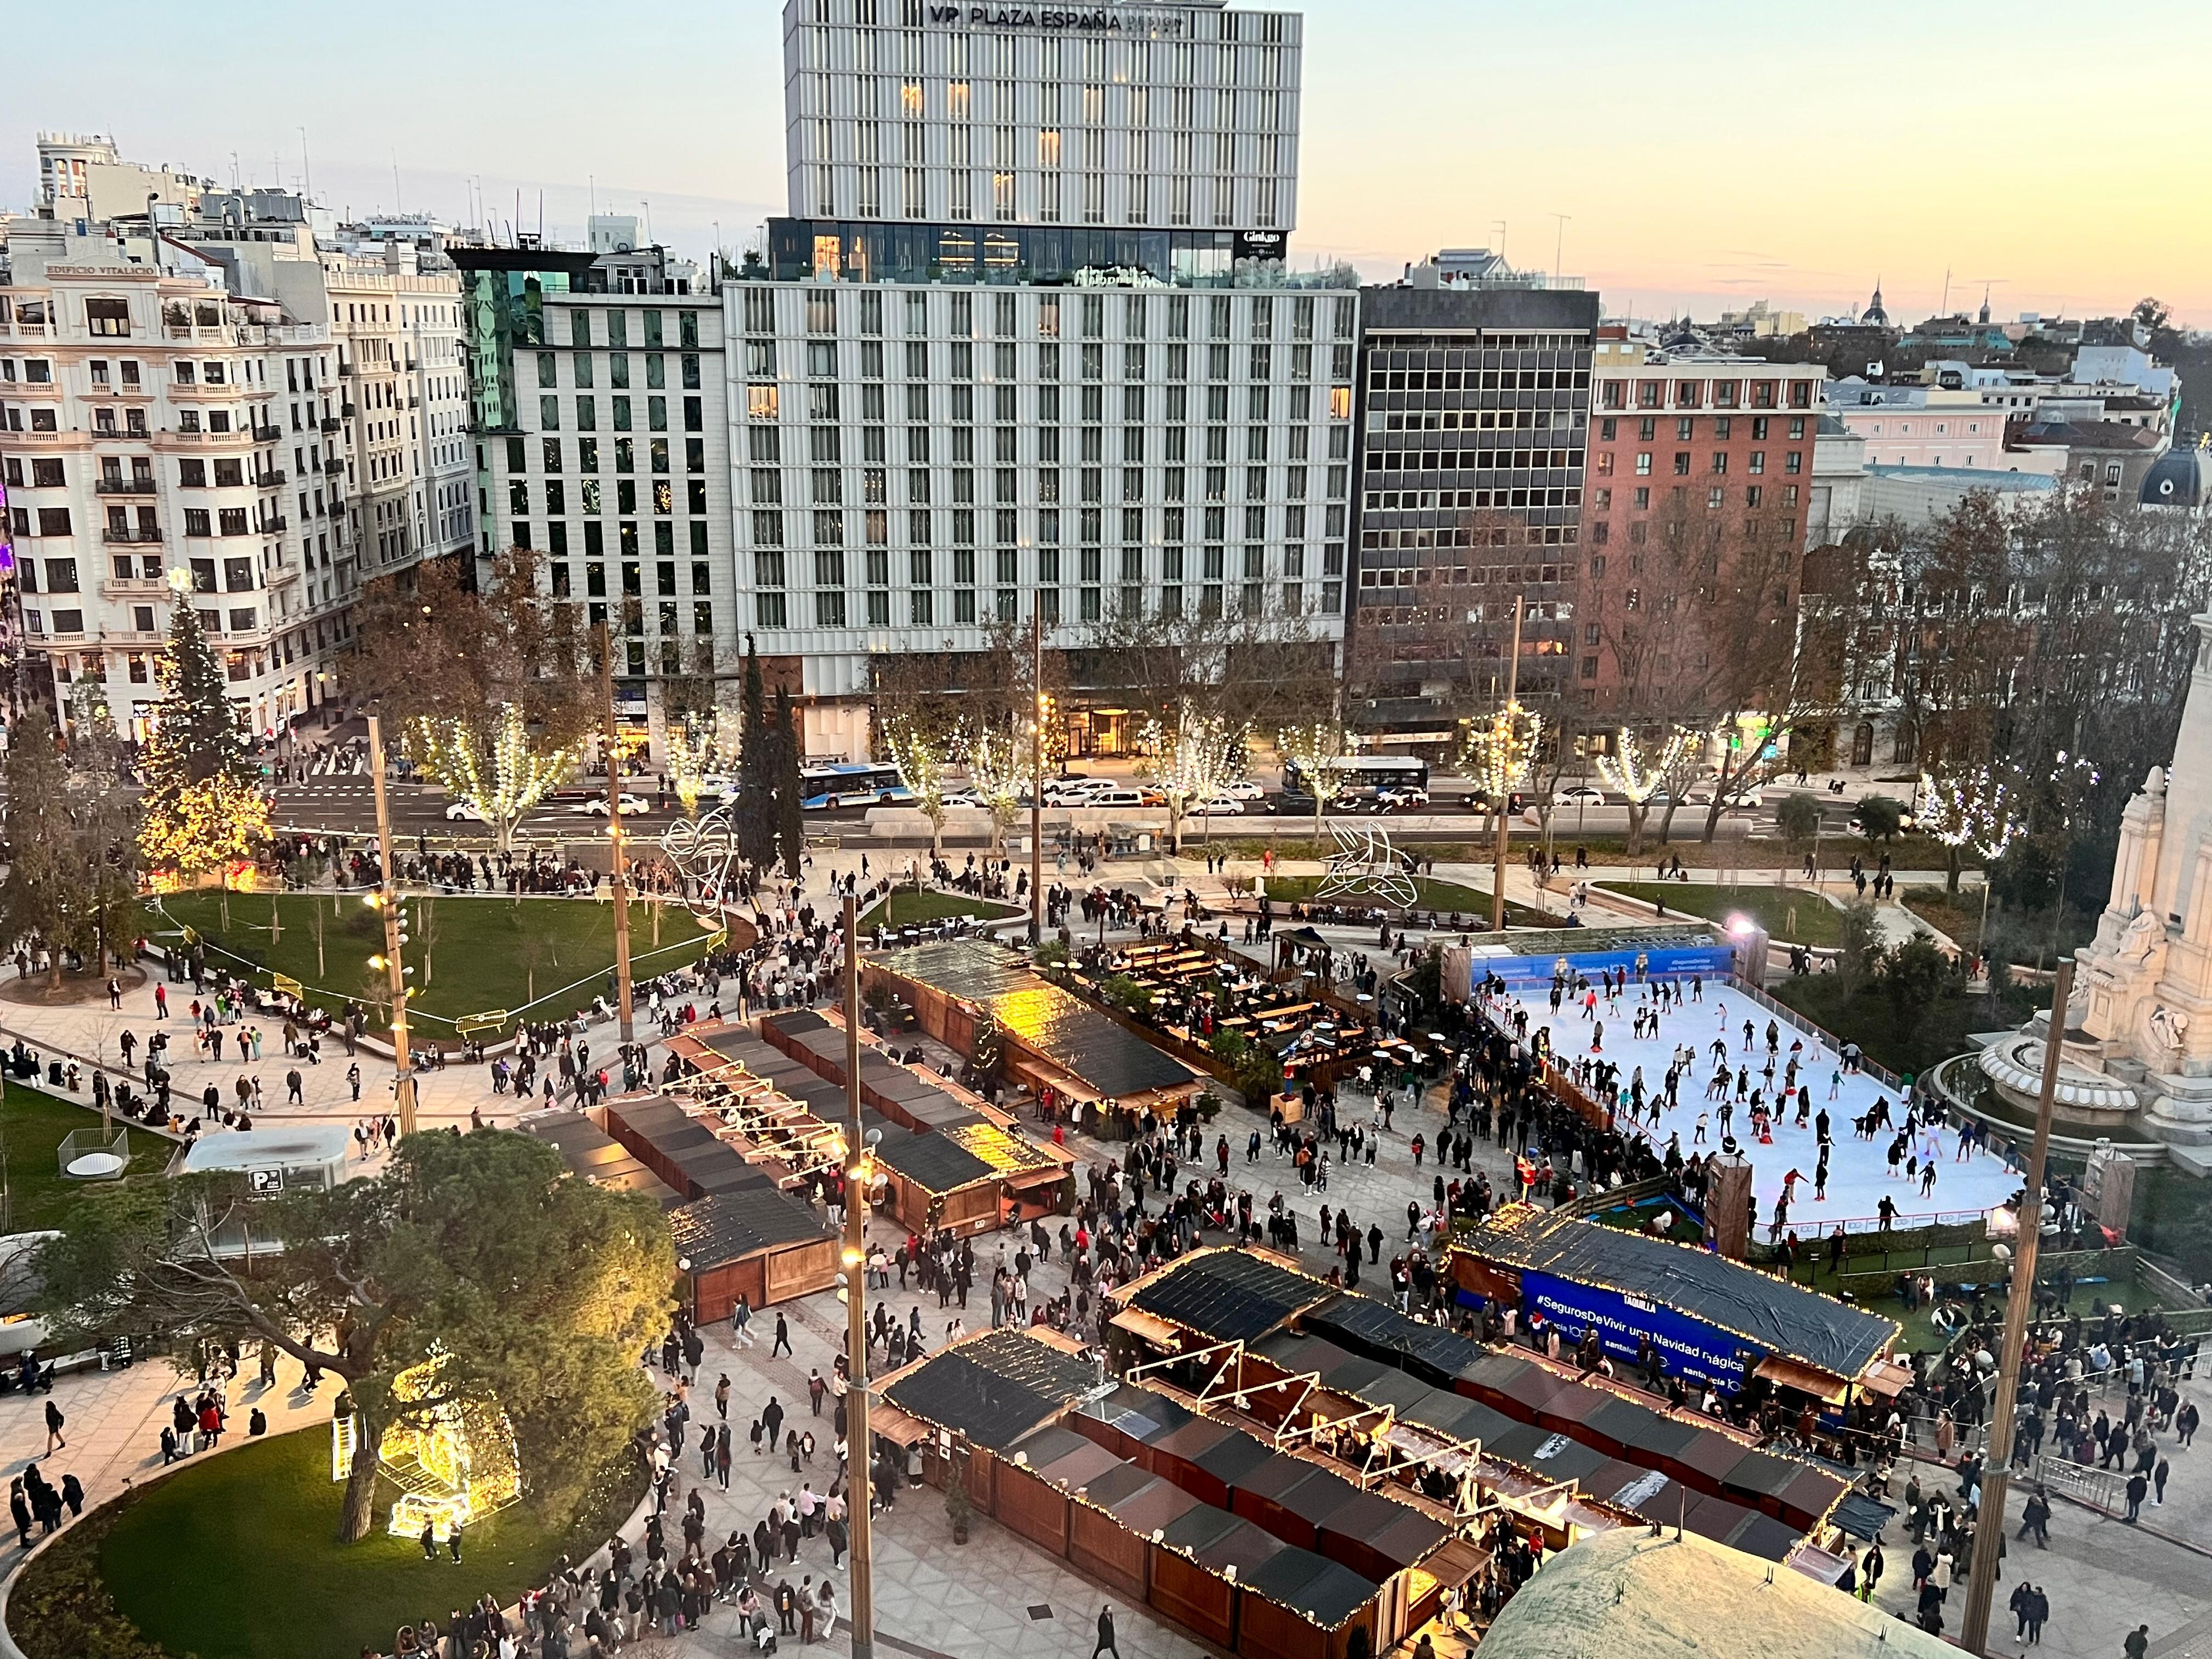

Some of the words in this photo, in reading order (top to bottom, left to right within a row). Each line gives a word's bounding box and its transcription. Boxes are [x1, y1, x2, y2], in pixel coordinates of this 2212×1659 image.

[930, 6, 959, 22] VP
[971, 8, 1035, 27] PLAZA
[1041, 10, 1122, 30] ESPAÑA
[1244, 231, 1280, 242] Ginkgo
[253, 1172, 268, 1189] P
[1624, 1295, 1656, 1313] TAQUILLA
[1537, 1295, 1627, 1332] #SegurosDeVivir
[1654, 1333, 1699, 1357] Navidad
[1605, 1340, 1638, 1356] santaluc
[1683, 1367, 1725, 1386] santacía
